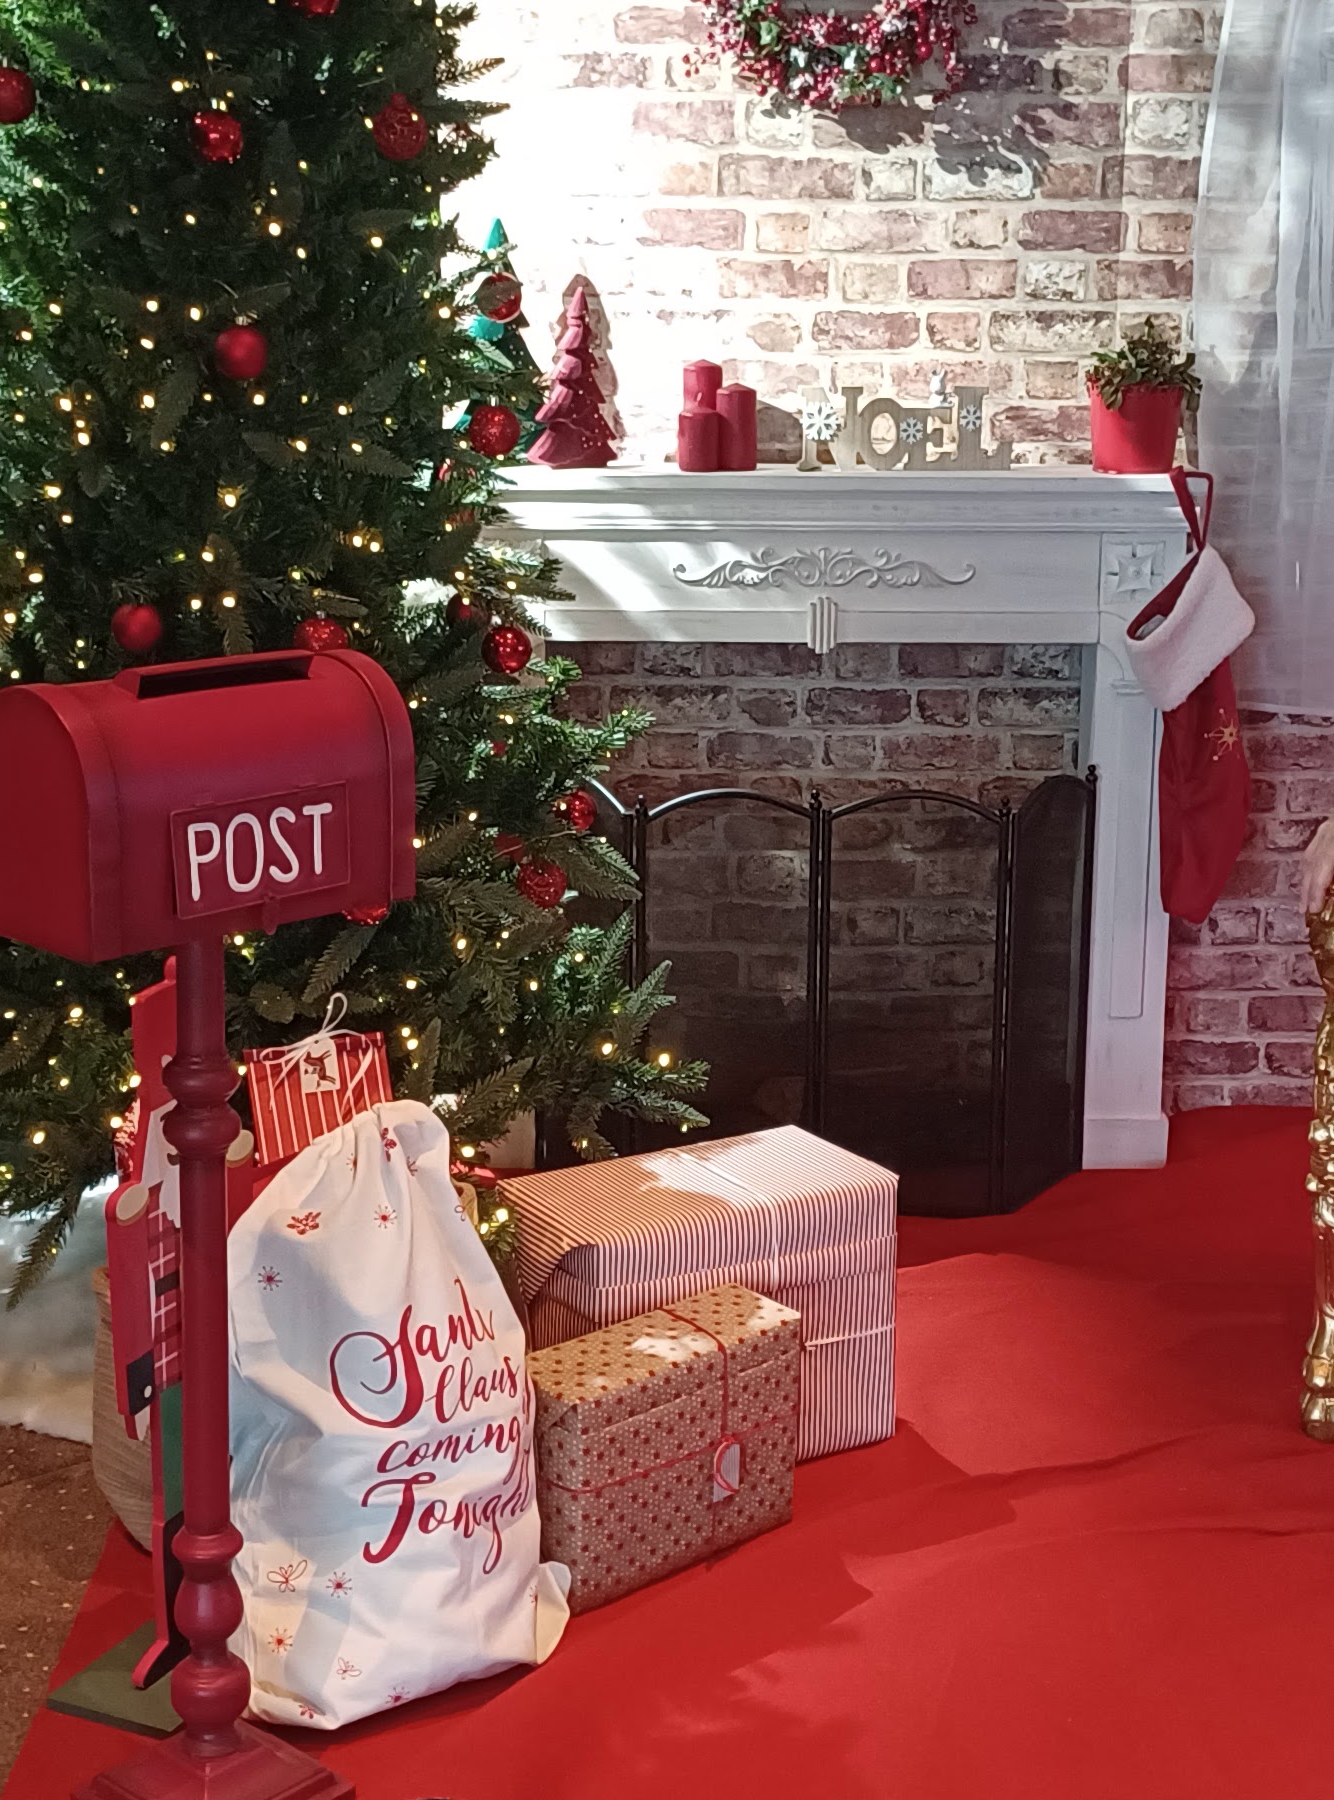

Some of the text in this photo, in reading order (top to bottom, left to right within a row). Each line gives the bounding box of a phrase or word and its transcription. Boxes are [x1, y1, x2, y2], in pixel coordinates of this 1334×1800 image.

[796, 386, 1013, 472] NOEL
[187, 802, 333, 901] POST
[425, 1355, 521, 1423] Claus
[377, 1416, 521, 1485] coming
